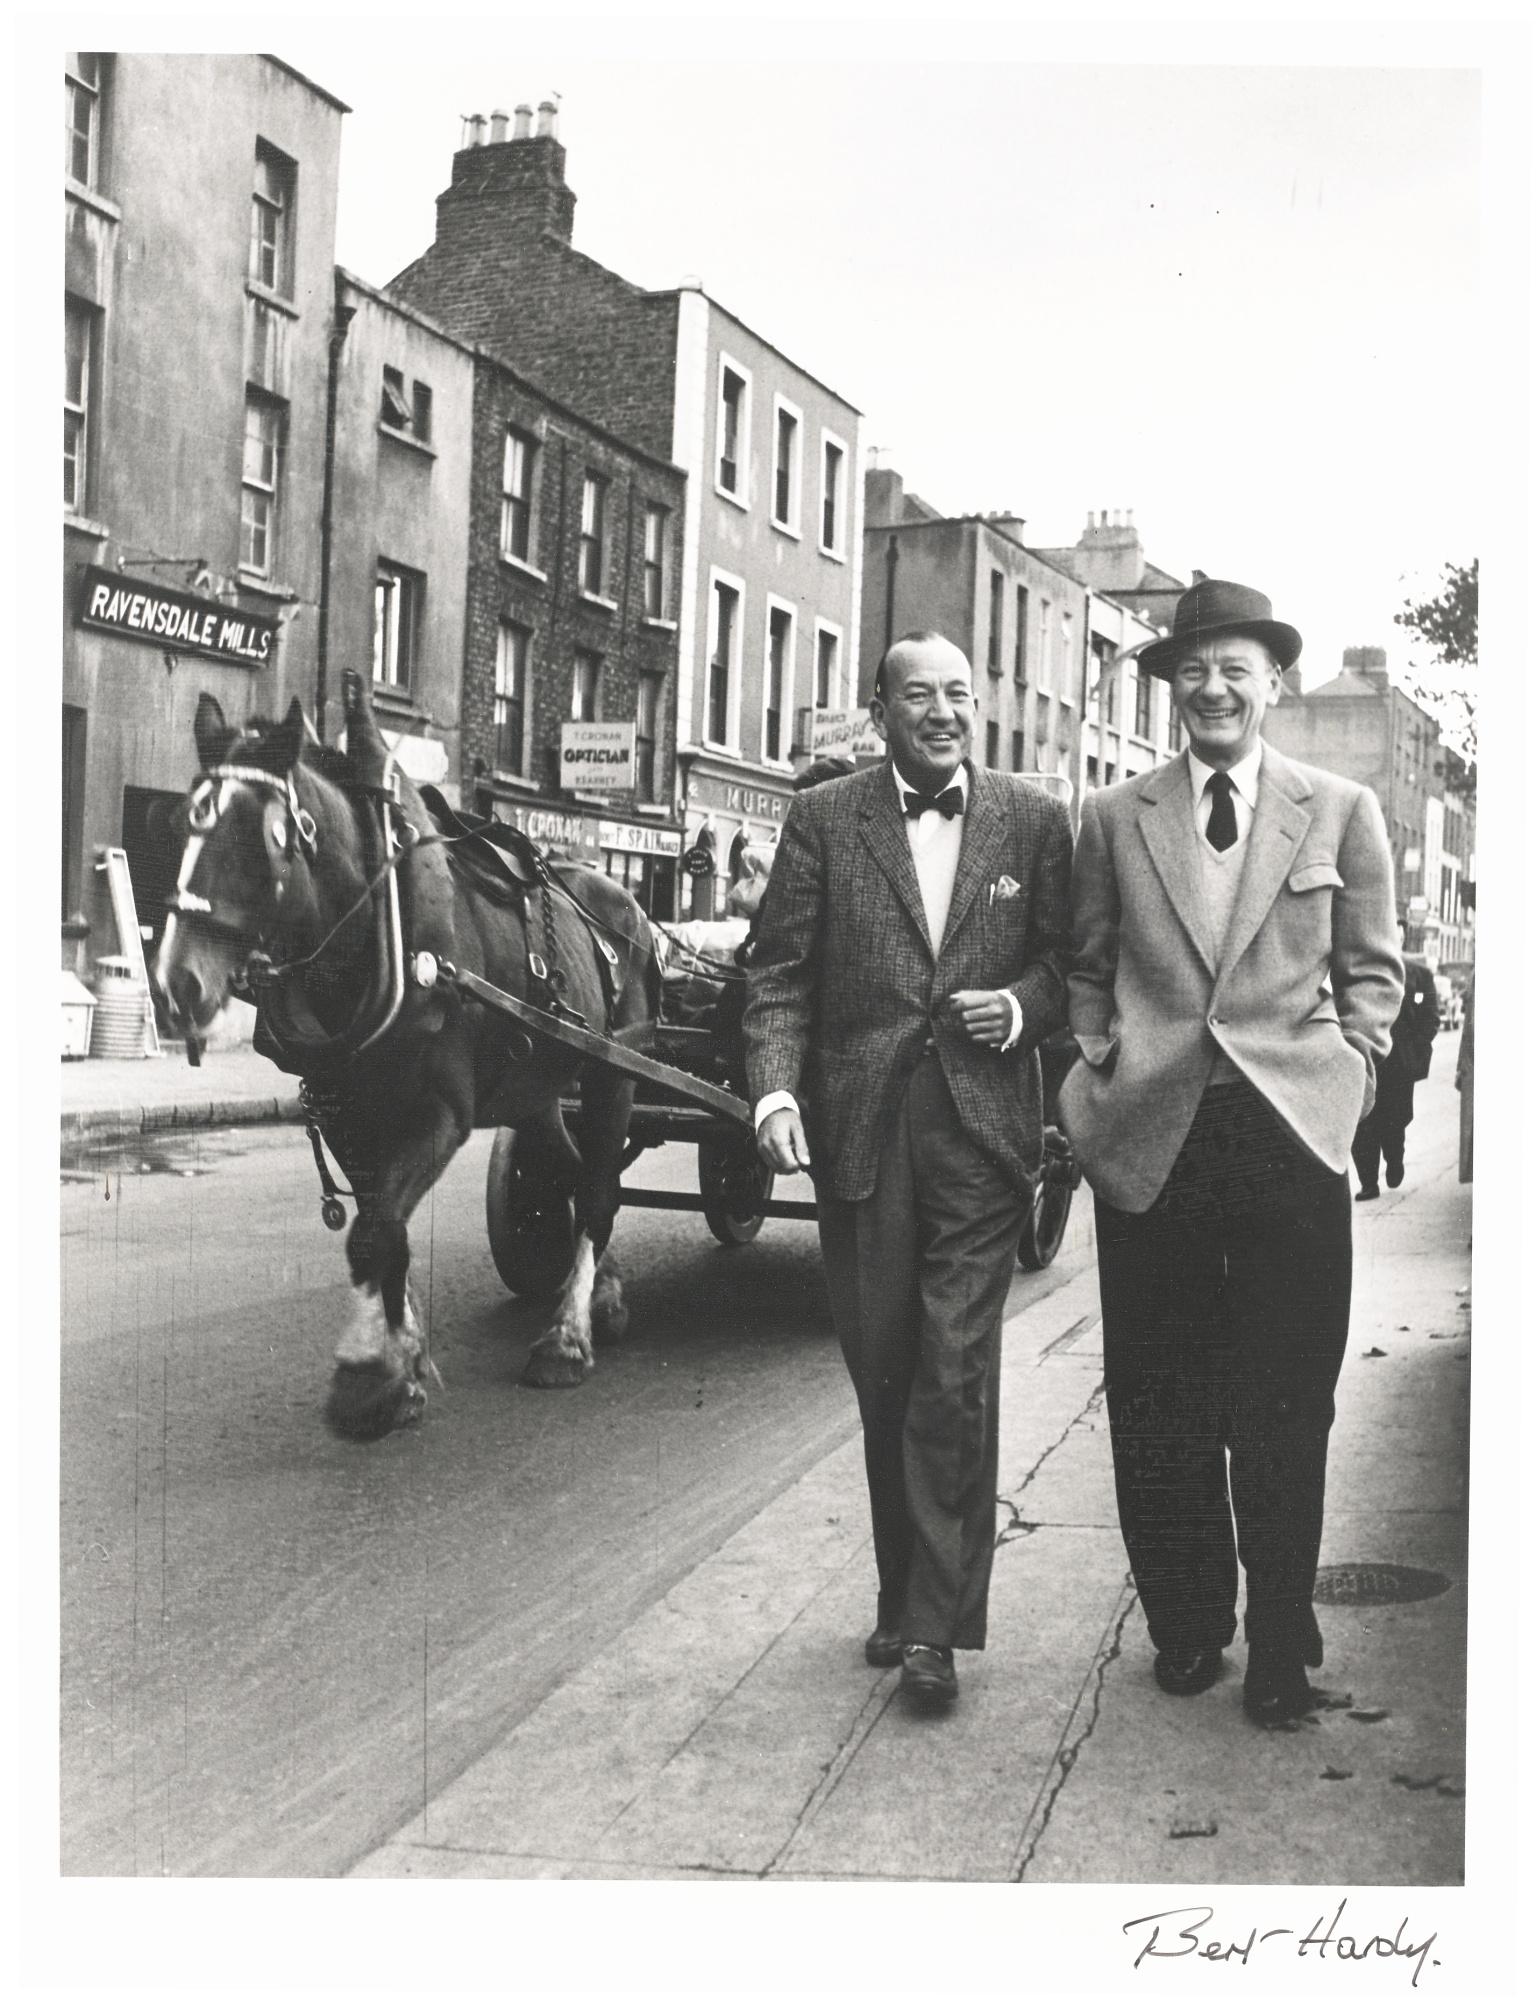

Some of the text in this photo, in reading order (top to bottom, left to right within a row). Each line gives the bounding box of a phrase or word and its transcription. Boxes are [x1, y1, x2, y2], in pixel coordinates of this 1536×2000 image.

[91, 585, 271, 659] RAVENSDALE MILLS
[564, 748, 629, 764] OPTICIAN
[727, 787, 788, 818] MURR
[1123, 1906, 1293, 1969] Bert
